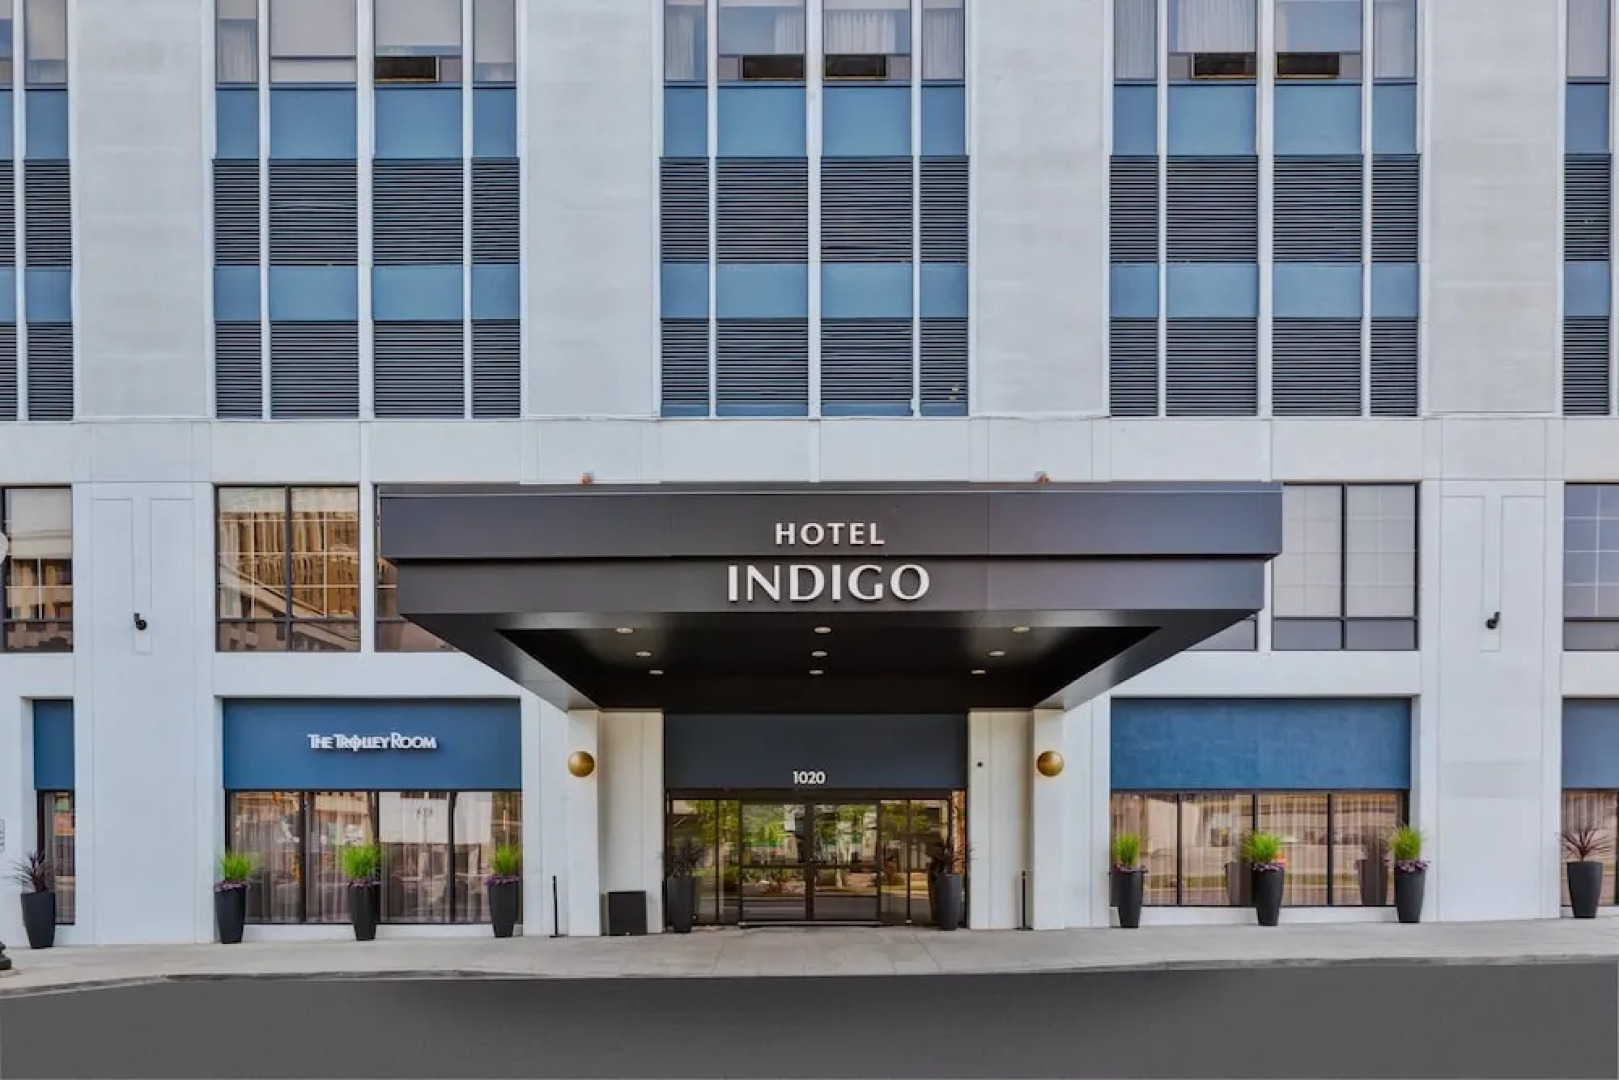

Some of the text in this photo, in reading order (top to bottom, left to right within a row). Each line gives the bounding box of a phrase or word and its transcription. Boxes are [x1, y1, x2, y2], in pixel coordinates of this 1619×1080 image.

[775, 522, 885, 545] HOTEL
[728, 564, 930, 602] INDIGO
[307, 734, 333, 749] THE
[390, 731, 437, 749] ROOM
[792, 770, 826, 785] 1020
